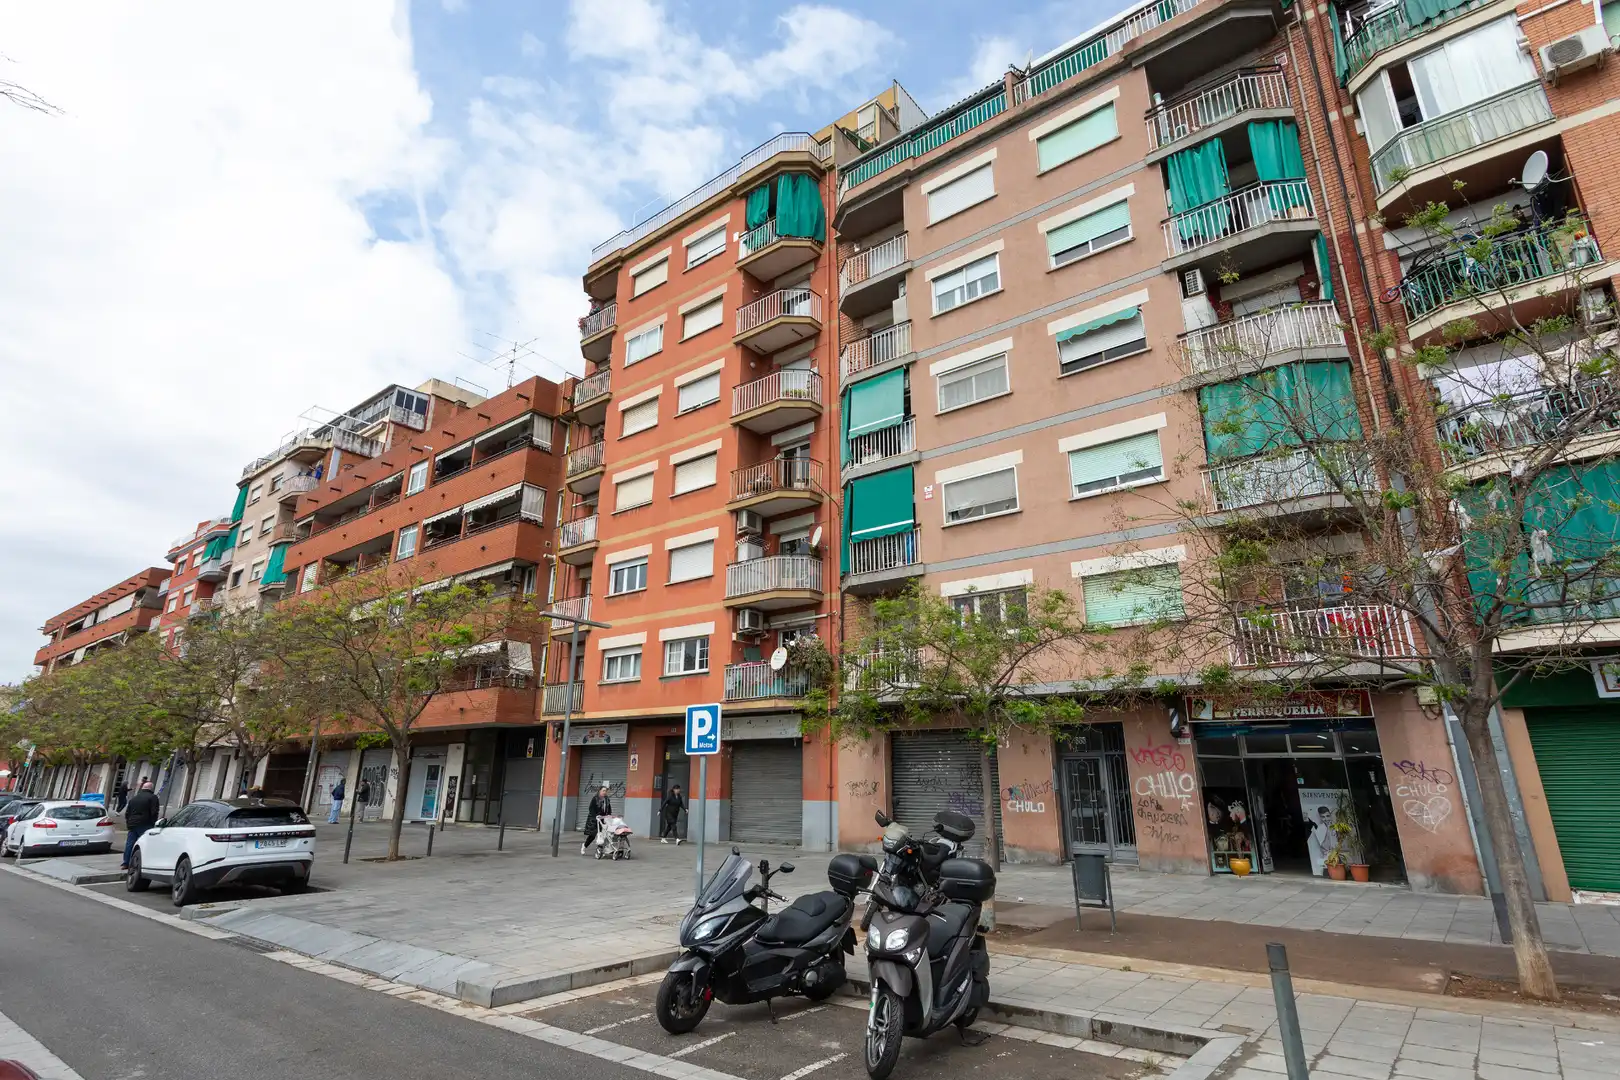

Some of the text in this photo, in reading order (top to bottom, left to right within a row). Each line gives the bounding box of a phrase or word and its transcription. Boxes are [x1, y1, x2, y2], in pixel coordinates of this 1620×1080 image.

[1232, 703, 1325, 718] PERRUQUERÍA
[692, 710, 712, 749] P
[1135, 771, 1195, 799] CHULO
[1396, 783, 1448, 797] CHULO
[1007, 800, 1045, 813] CHULO
